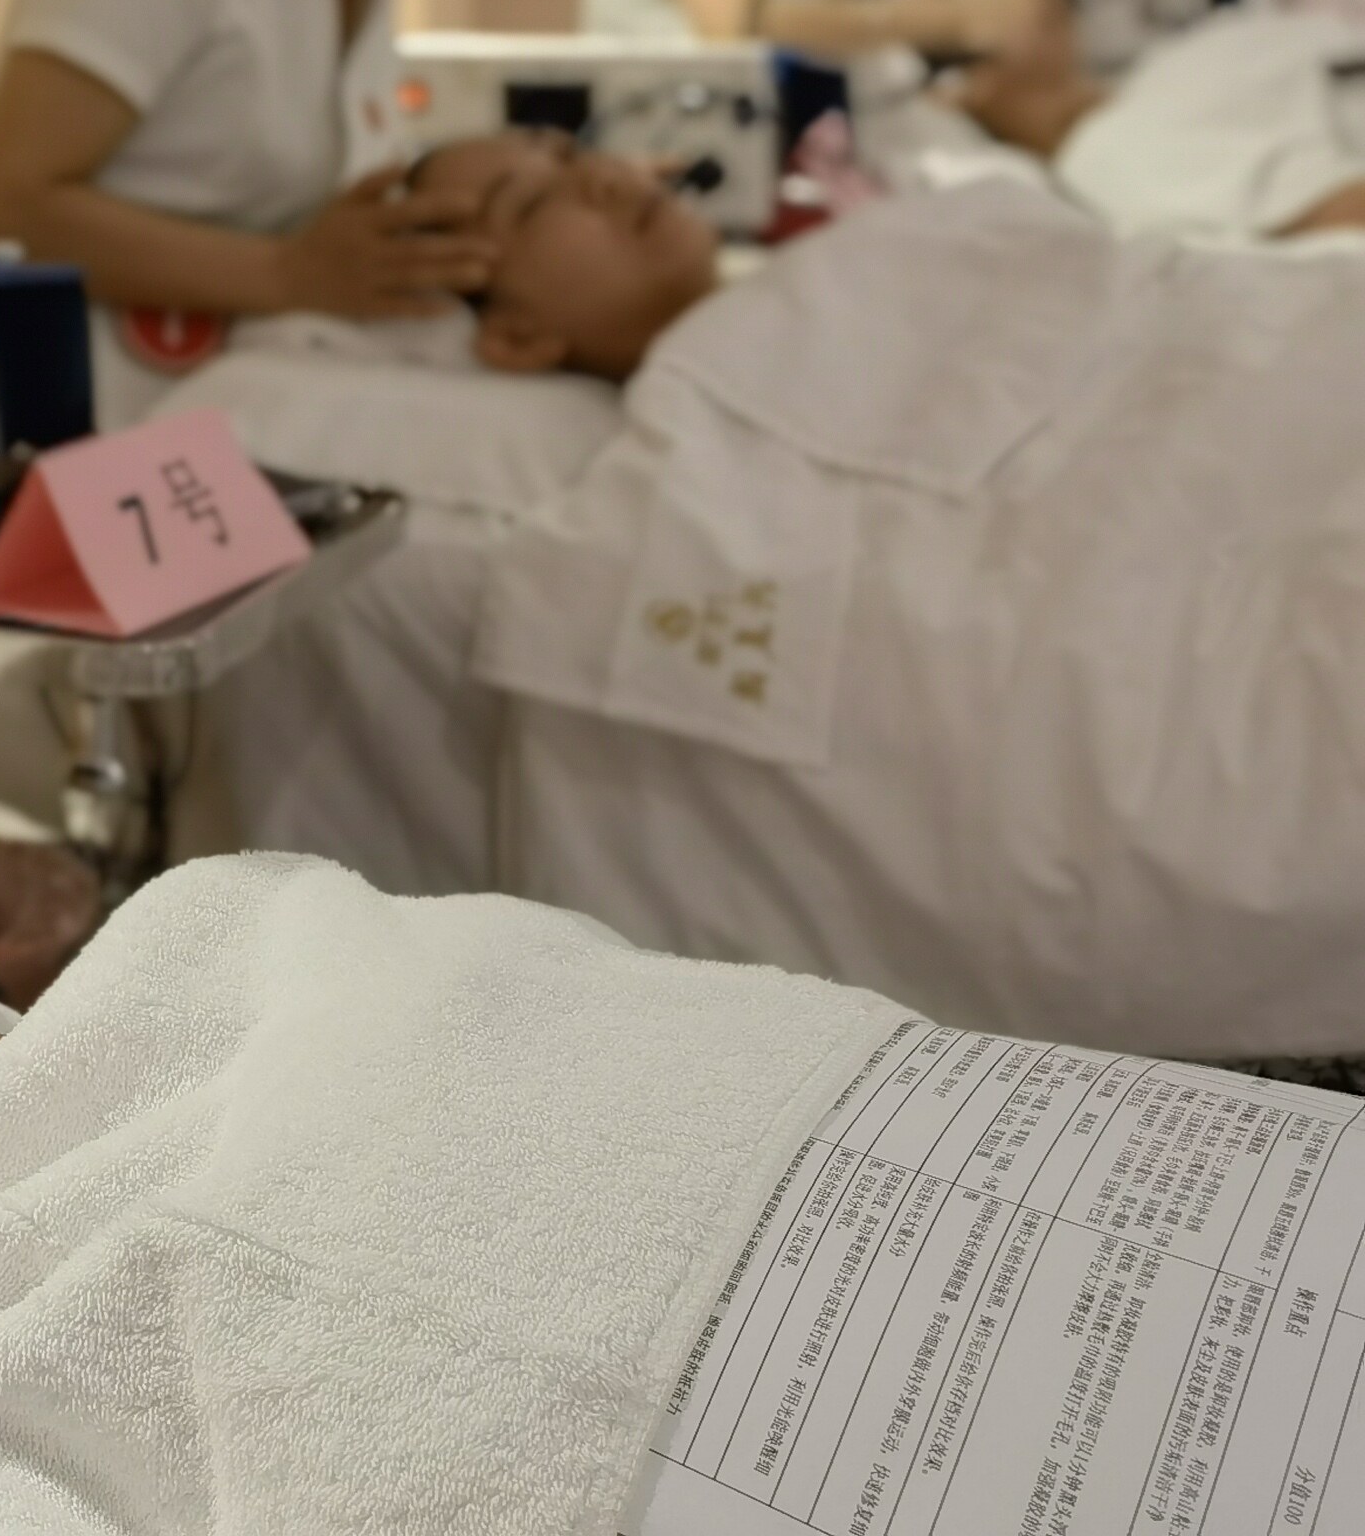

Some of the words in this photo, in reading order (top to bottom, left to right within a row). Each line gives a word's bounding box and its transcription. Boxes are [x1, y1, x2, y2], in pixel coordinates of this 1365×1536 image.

[780, 1145, 859, 1269] 操作完给你拍张照，对比效果。
[889, 1174, 944, 1257] 给皮肤补充大量水分
[922, 1207, 1043, 1475] 在操作之前给你拍张照，操作完后给你存档对比效果。
[1284, 1287, 1320, 1338] 操作重点
[1044, 1248, 1165, 1536] 全脸清洁，卸妆凝胶特有的吸附功能可以1分钟黑头浮
[1284, 1465, 1317, 1526] 分值100
